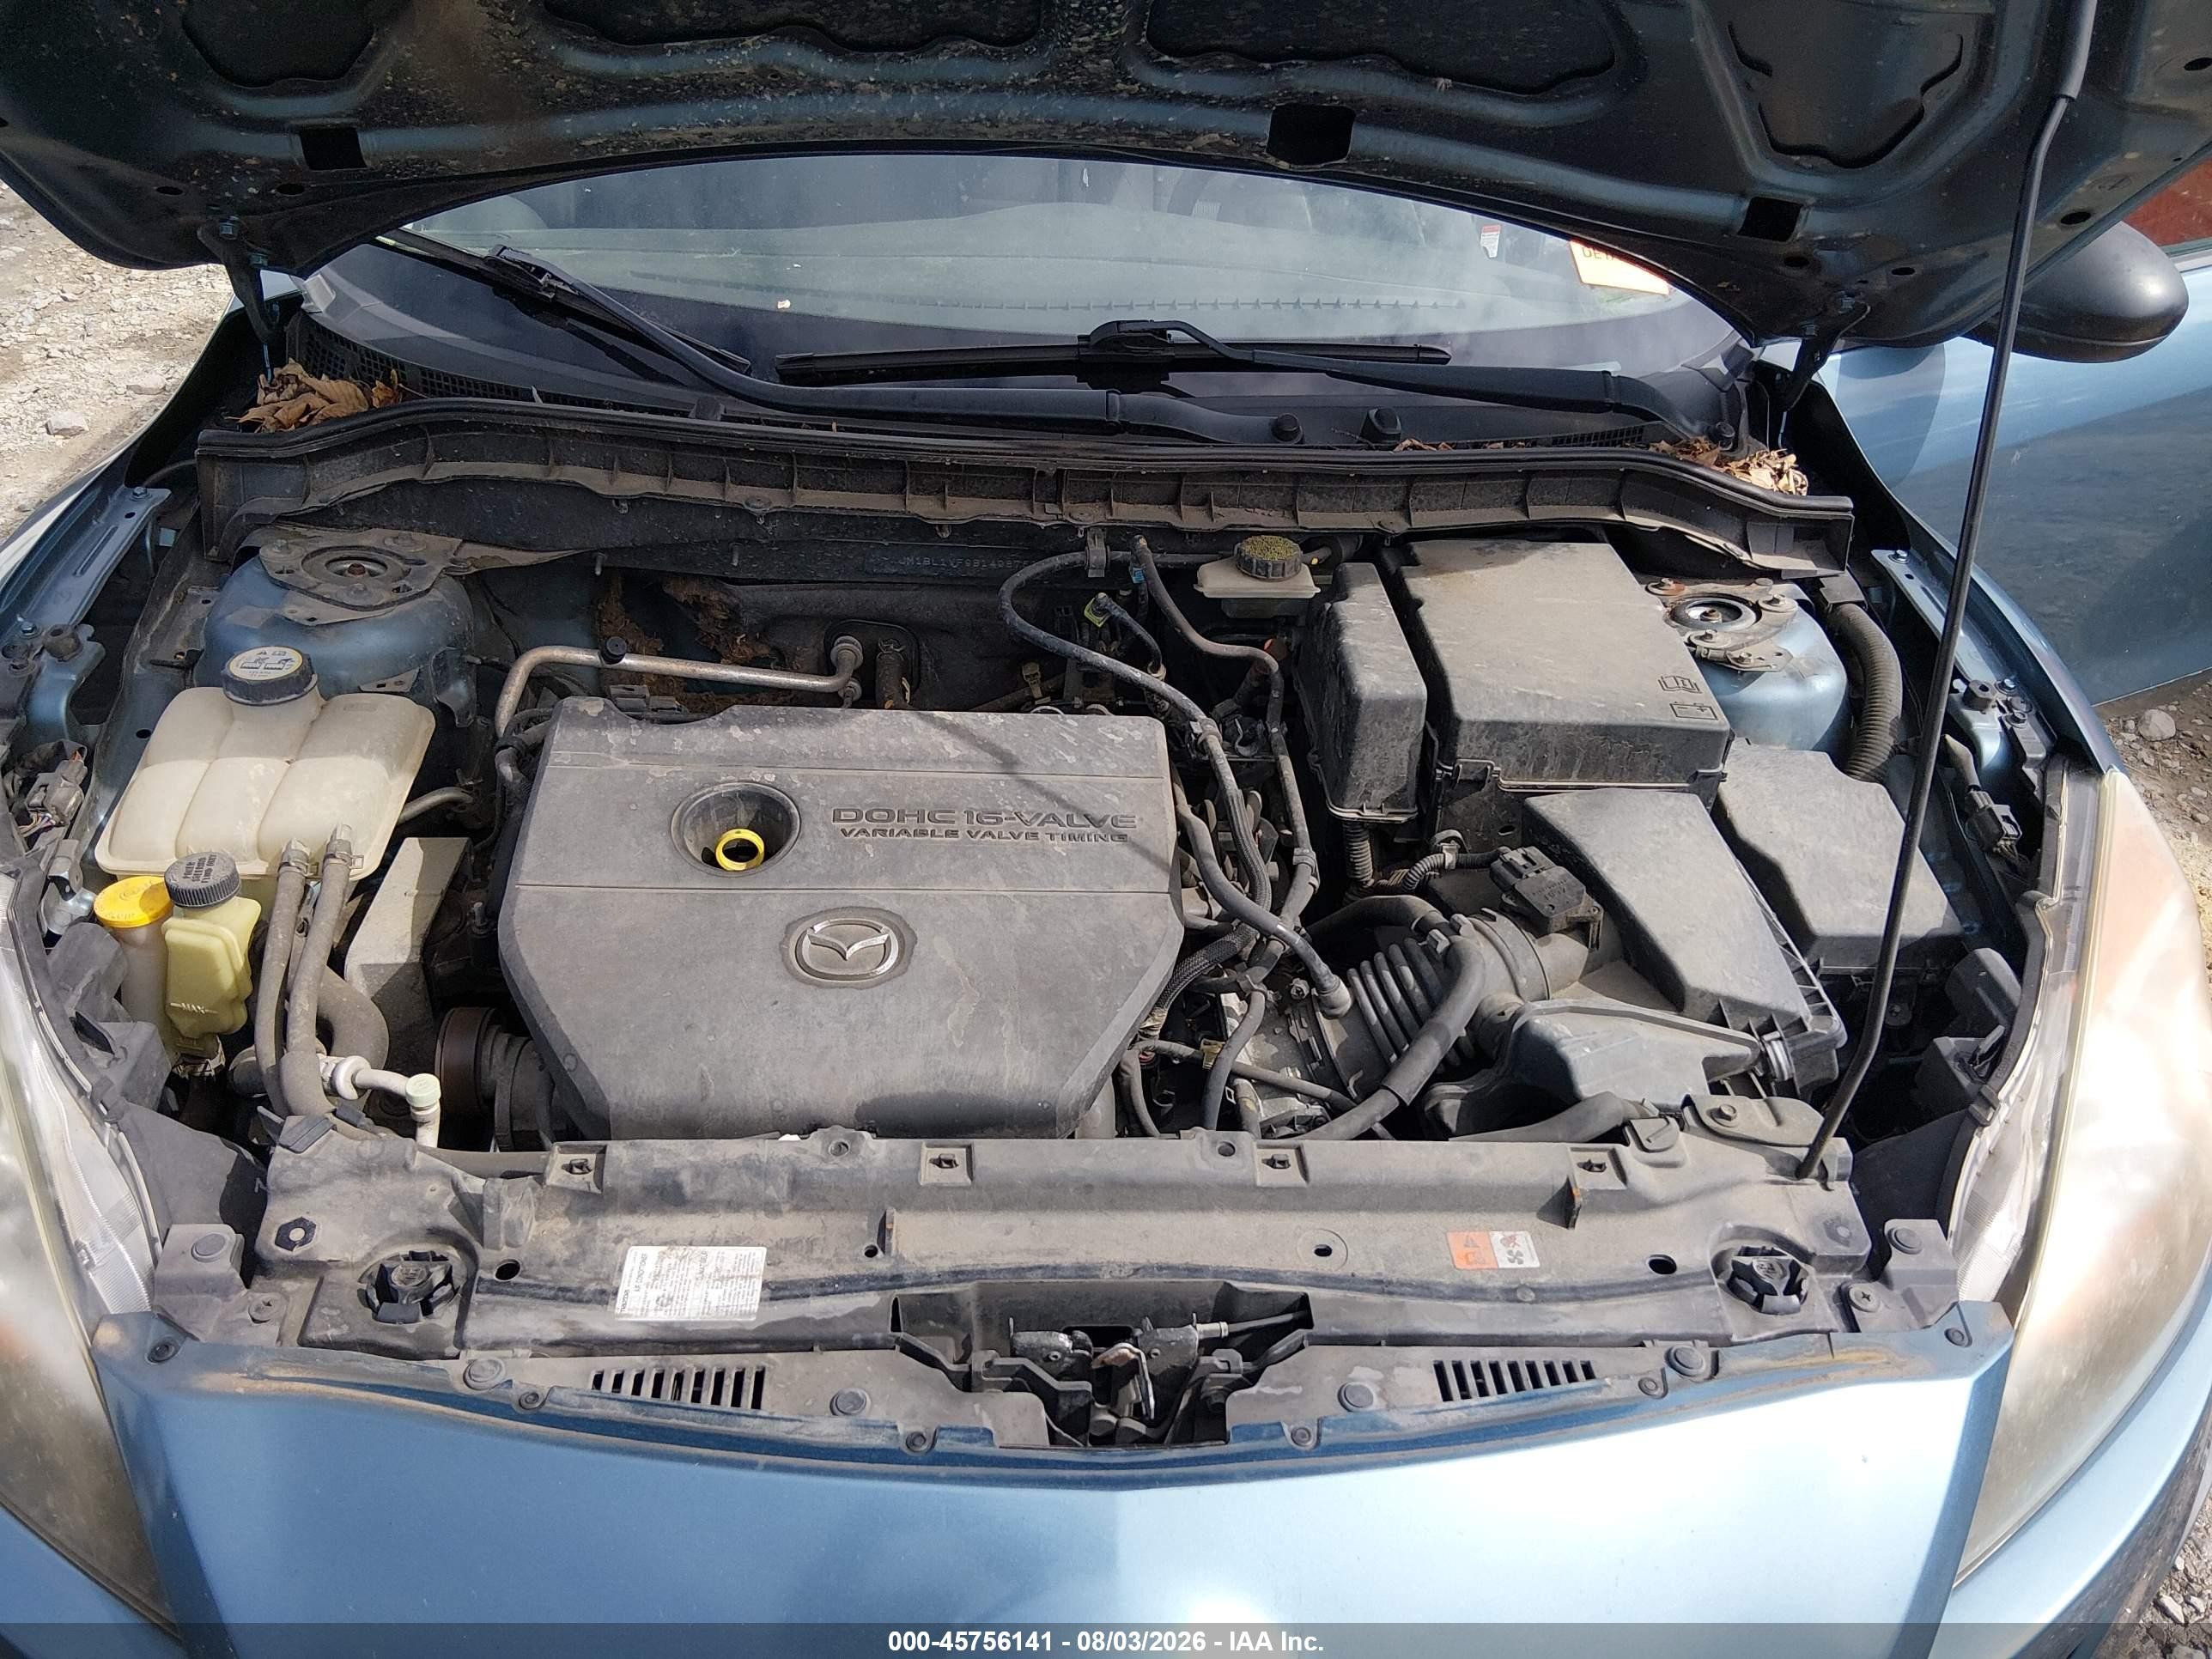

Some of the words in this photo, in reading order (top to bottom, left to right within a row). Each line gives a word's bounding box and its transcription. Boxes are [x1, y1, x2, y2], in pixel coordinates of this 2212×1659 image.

[832, 808, 955, 825] DOHC
[963, 810, 1137, 829] 16-VALVE
[840, 828, 958, 839] VARIABLE
[967, 830, 1039, 842] VALVE
[1044, 832, 1127, 843] TIMING
[181, 1002, 205, 1014] MAX
